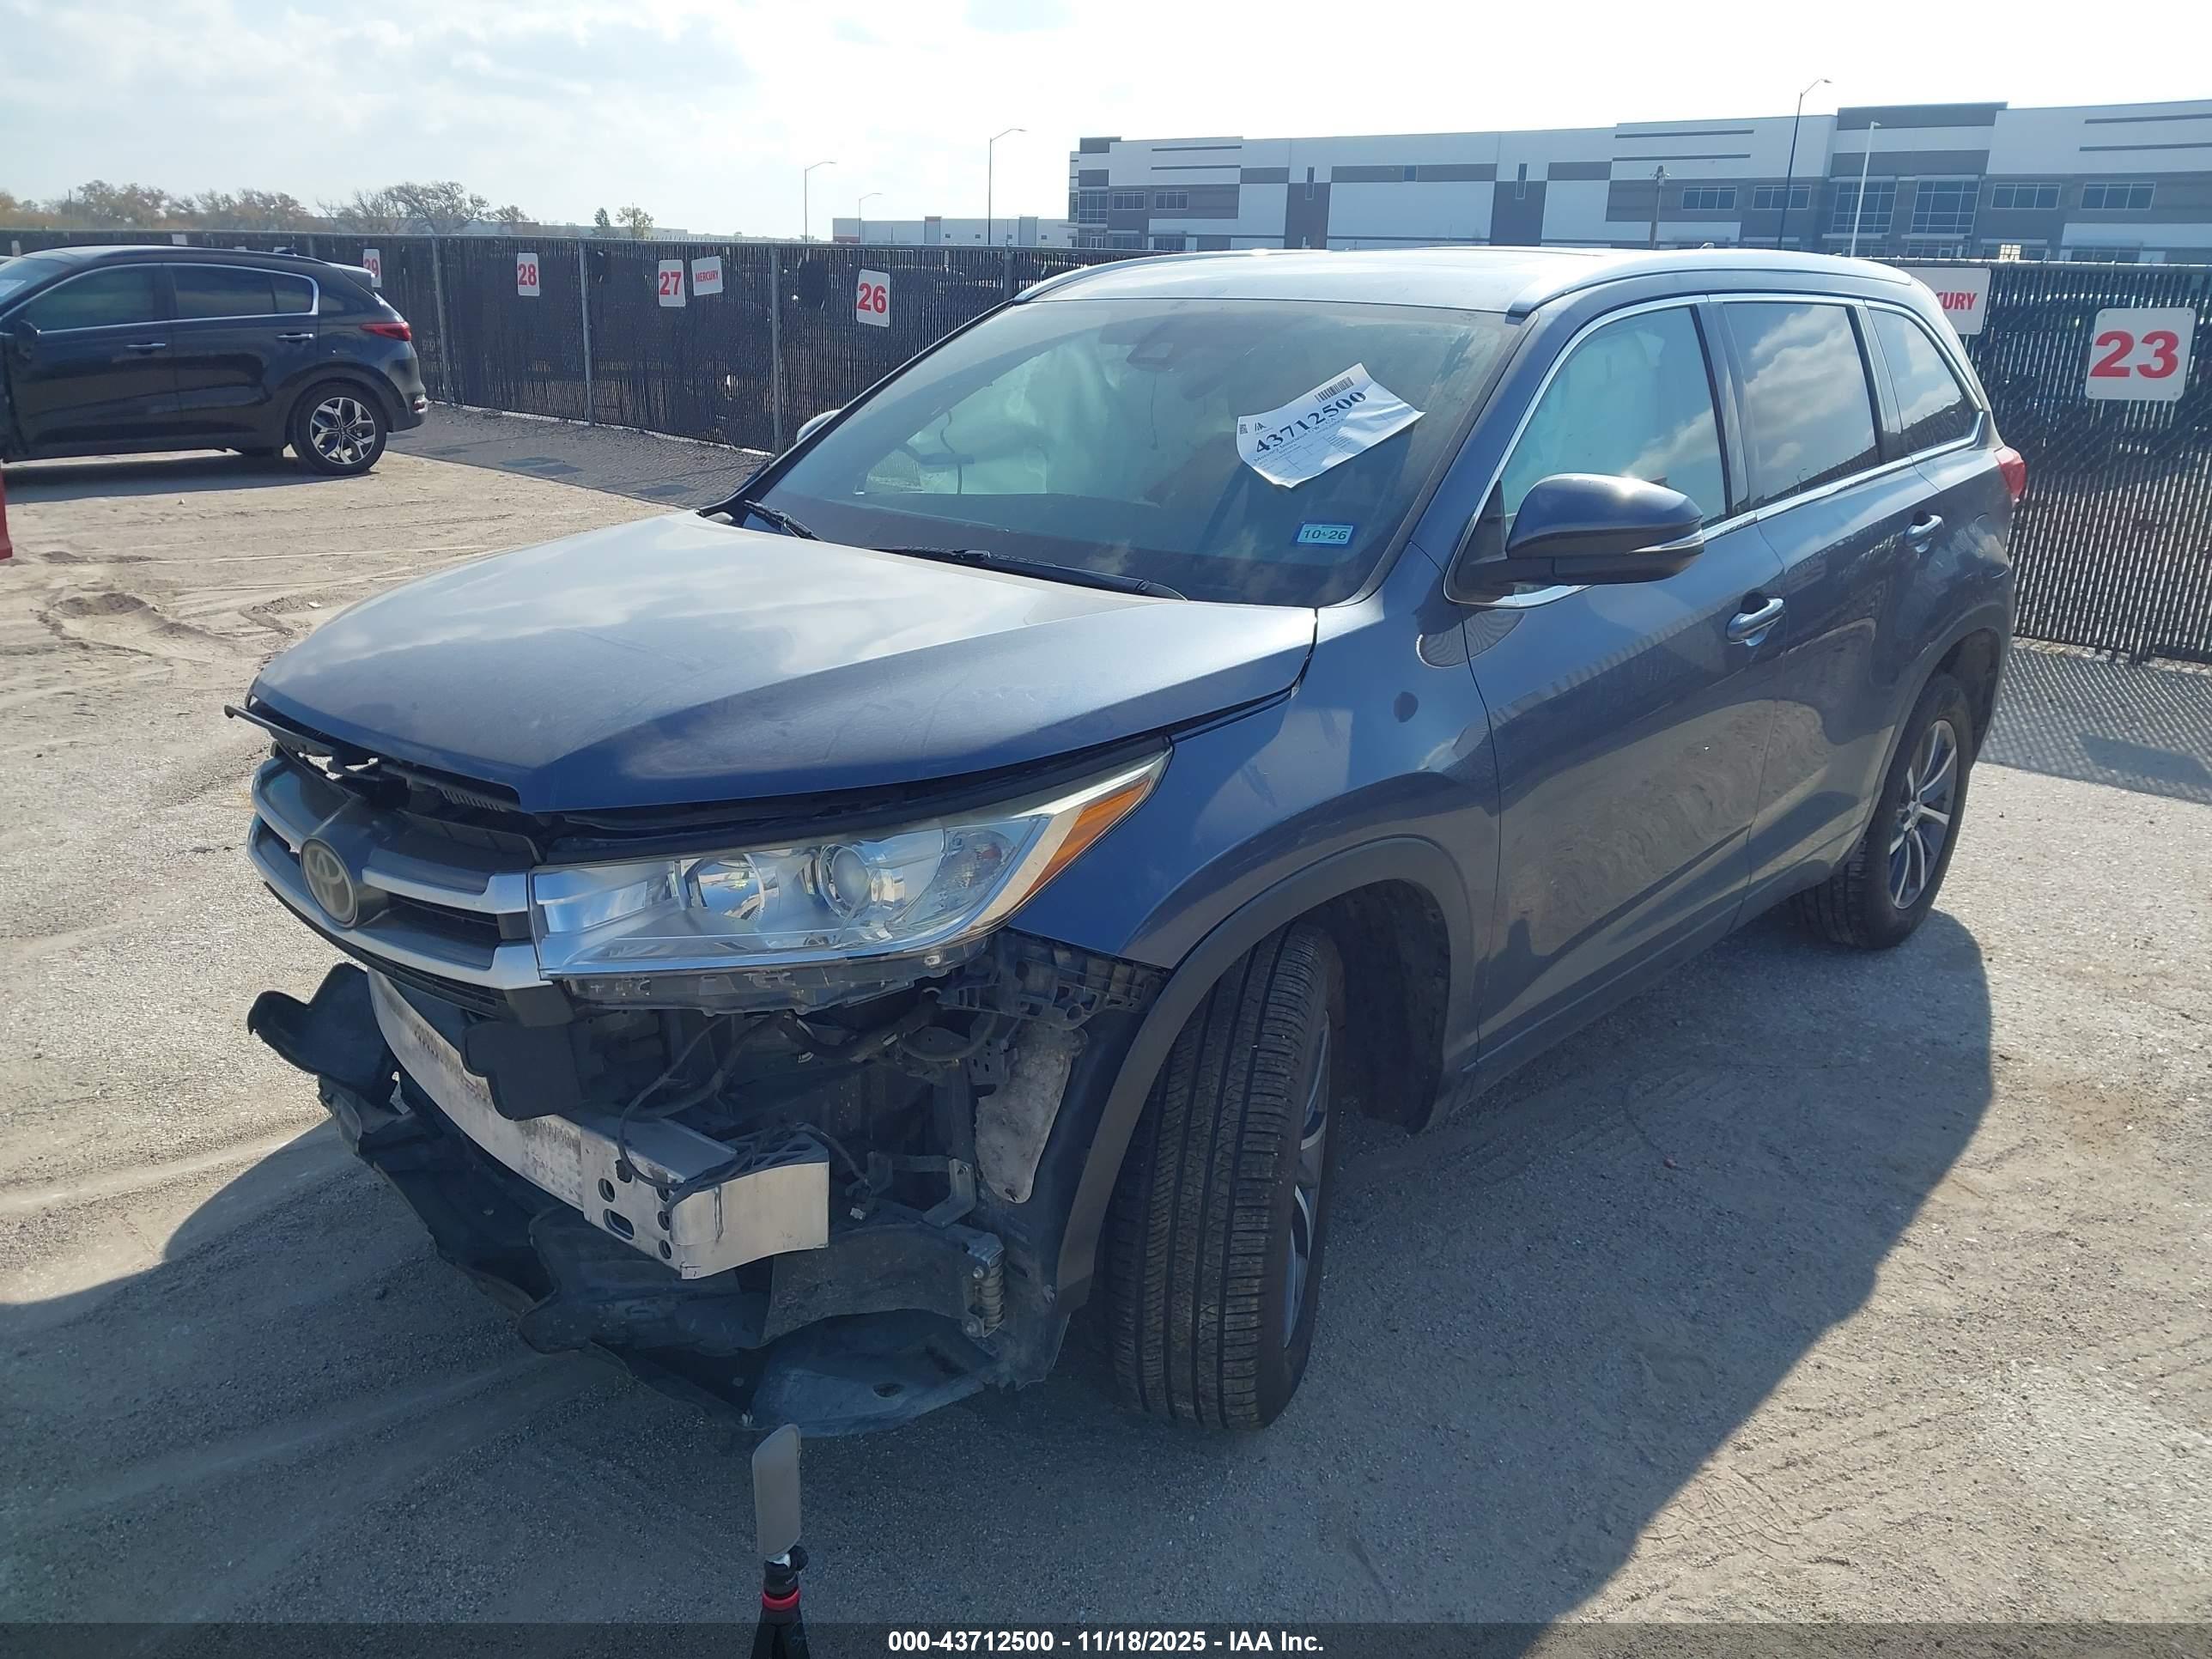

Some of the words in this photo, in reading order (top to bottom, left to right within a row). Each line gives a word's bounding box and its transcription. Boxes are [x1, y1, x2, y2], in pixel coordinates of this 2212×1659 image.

[518, 264, 537, 286] 28
[659, 271, 682, 296] 27
[695, 270, 720, 283] MERCURY
[857, 283, 887, 314] 26
[2089, 330, 2179, 380] 23
[1255, 391, 1368, 453] 43712500
